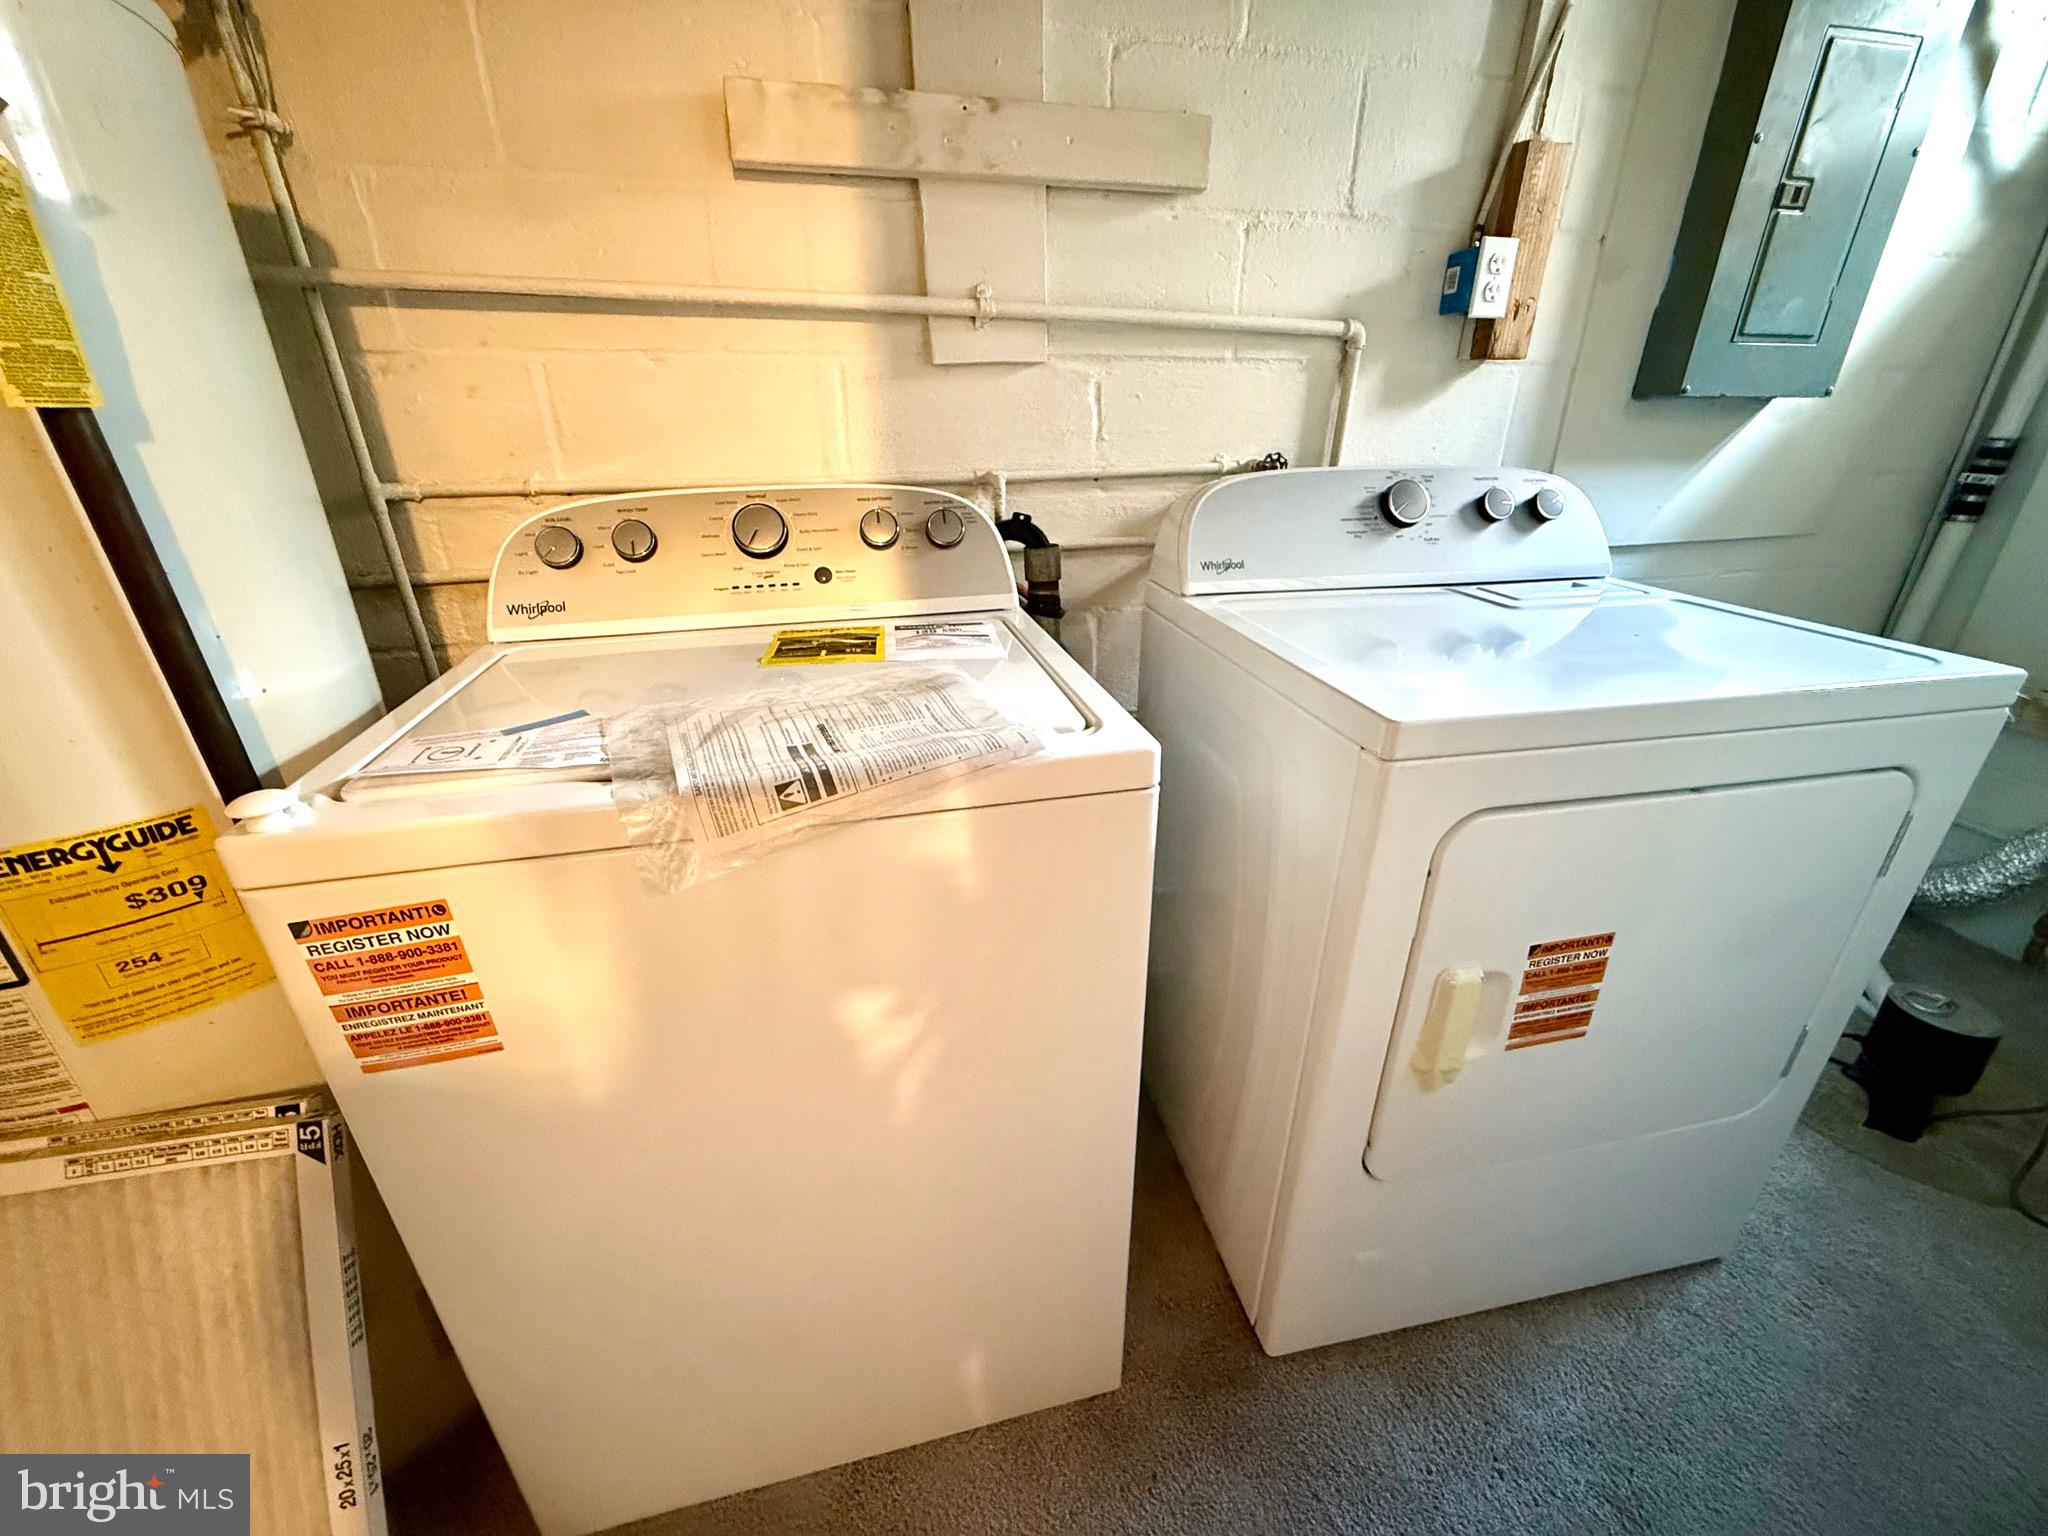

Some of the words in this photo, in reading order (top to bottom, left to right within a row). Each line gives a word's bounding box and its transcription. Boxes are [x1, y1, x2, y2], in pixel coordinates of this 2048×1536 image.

[1200, 558, 1245, 575] Whirlpool
[506, 600, 567, 620] Whirlpool
[92, 884, 120, 895] Yearly
[121, 873, 160, 888] Operating
[162, 867, 180, 878] Cost
[125, 875, 208, 910] $309
[313, 905, 432, 936] IMPORTANT!
[306, 931, 402, 957] REGISTER
[405, 923, 451, 942] NOW
[116, 952, 163, 974] 254
[314, 958, 354, 974] CALL
[357, 941, 460, 967] 1-888-900-3381
[321, 974, 338, 982] YOU
[339, 970, 362, 980] MUST
[363, 964, 401, 976] REGISTER
[402, 959, 425, 970] YOUR
[426, 953, 463, 966] PRODUCT
[1529, 953, 1581, 968] REGISTER
[1583, 948, 1609, 960] NOW
[342, 1014, 416, 1032] ENREGISTREZ
[418, 1002, 486, 1021] MAINTENANT
[345, 989, 468, 1018] IMPORTANTE!
[350, 1026, 397, 1042] APPELEZ
[398, 1024, 415, 1034] LE
[415, 1014, 488, 1032] 1-888-900-3381
[299, 1125, 321, 1140] 5
[300, 1140, 322, 1151] FPR
[333, 1442, 357, 1510] 20x25x1
